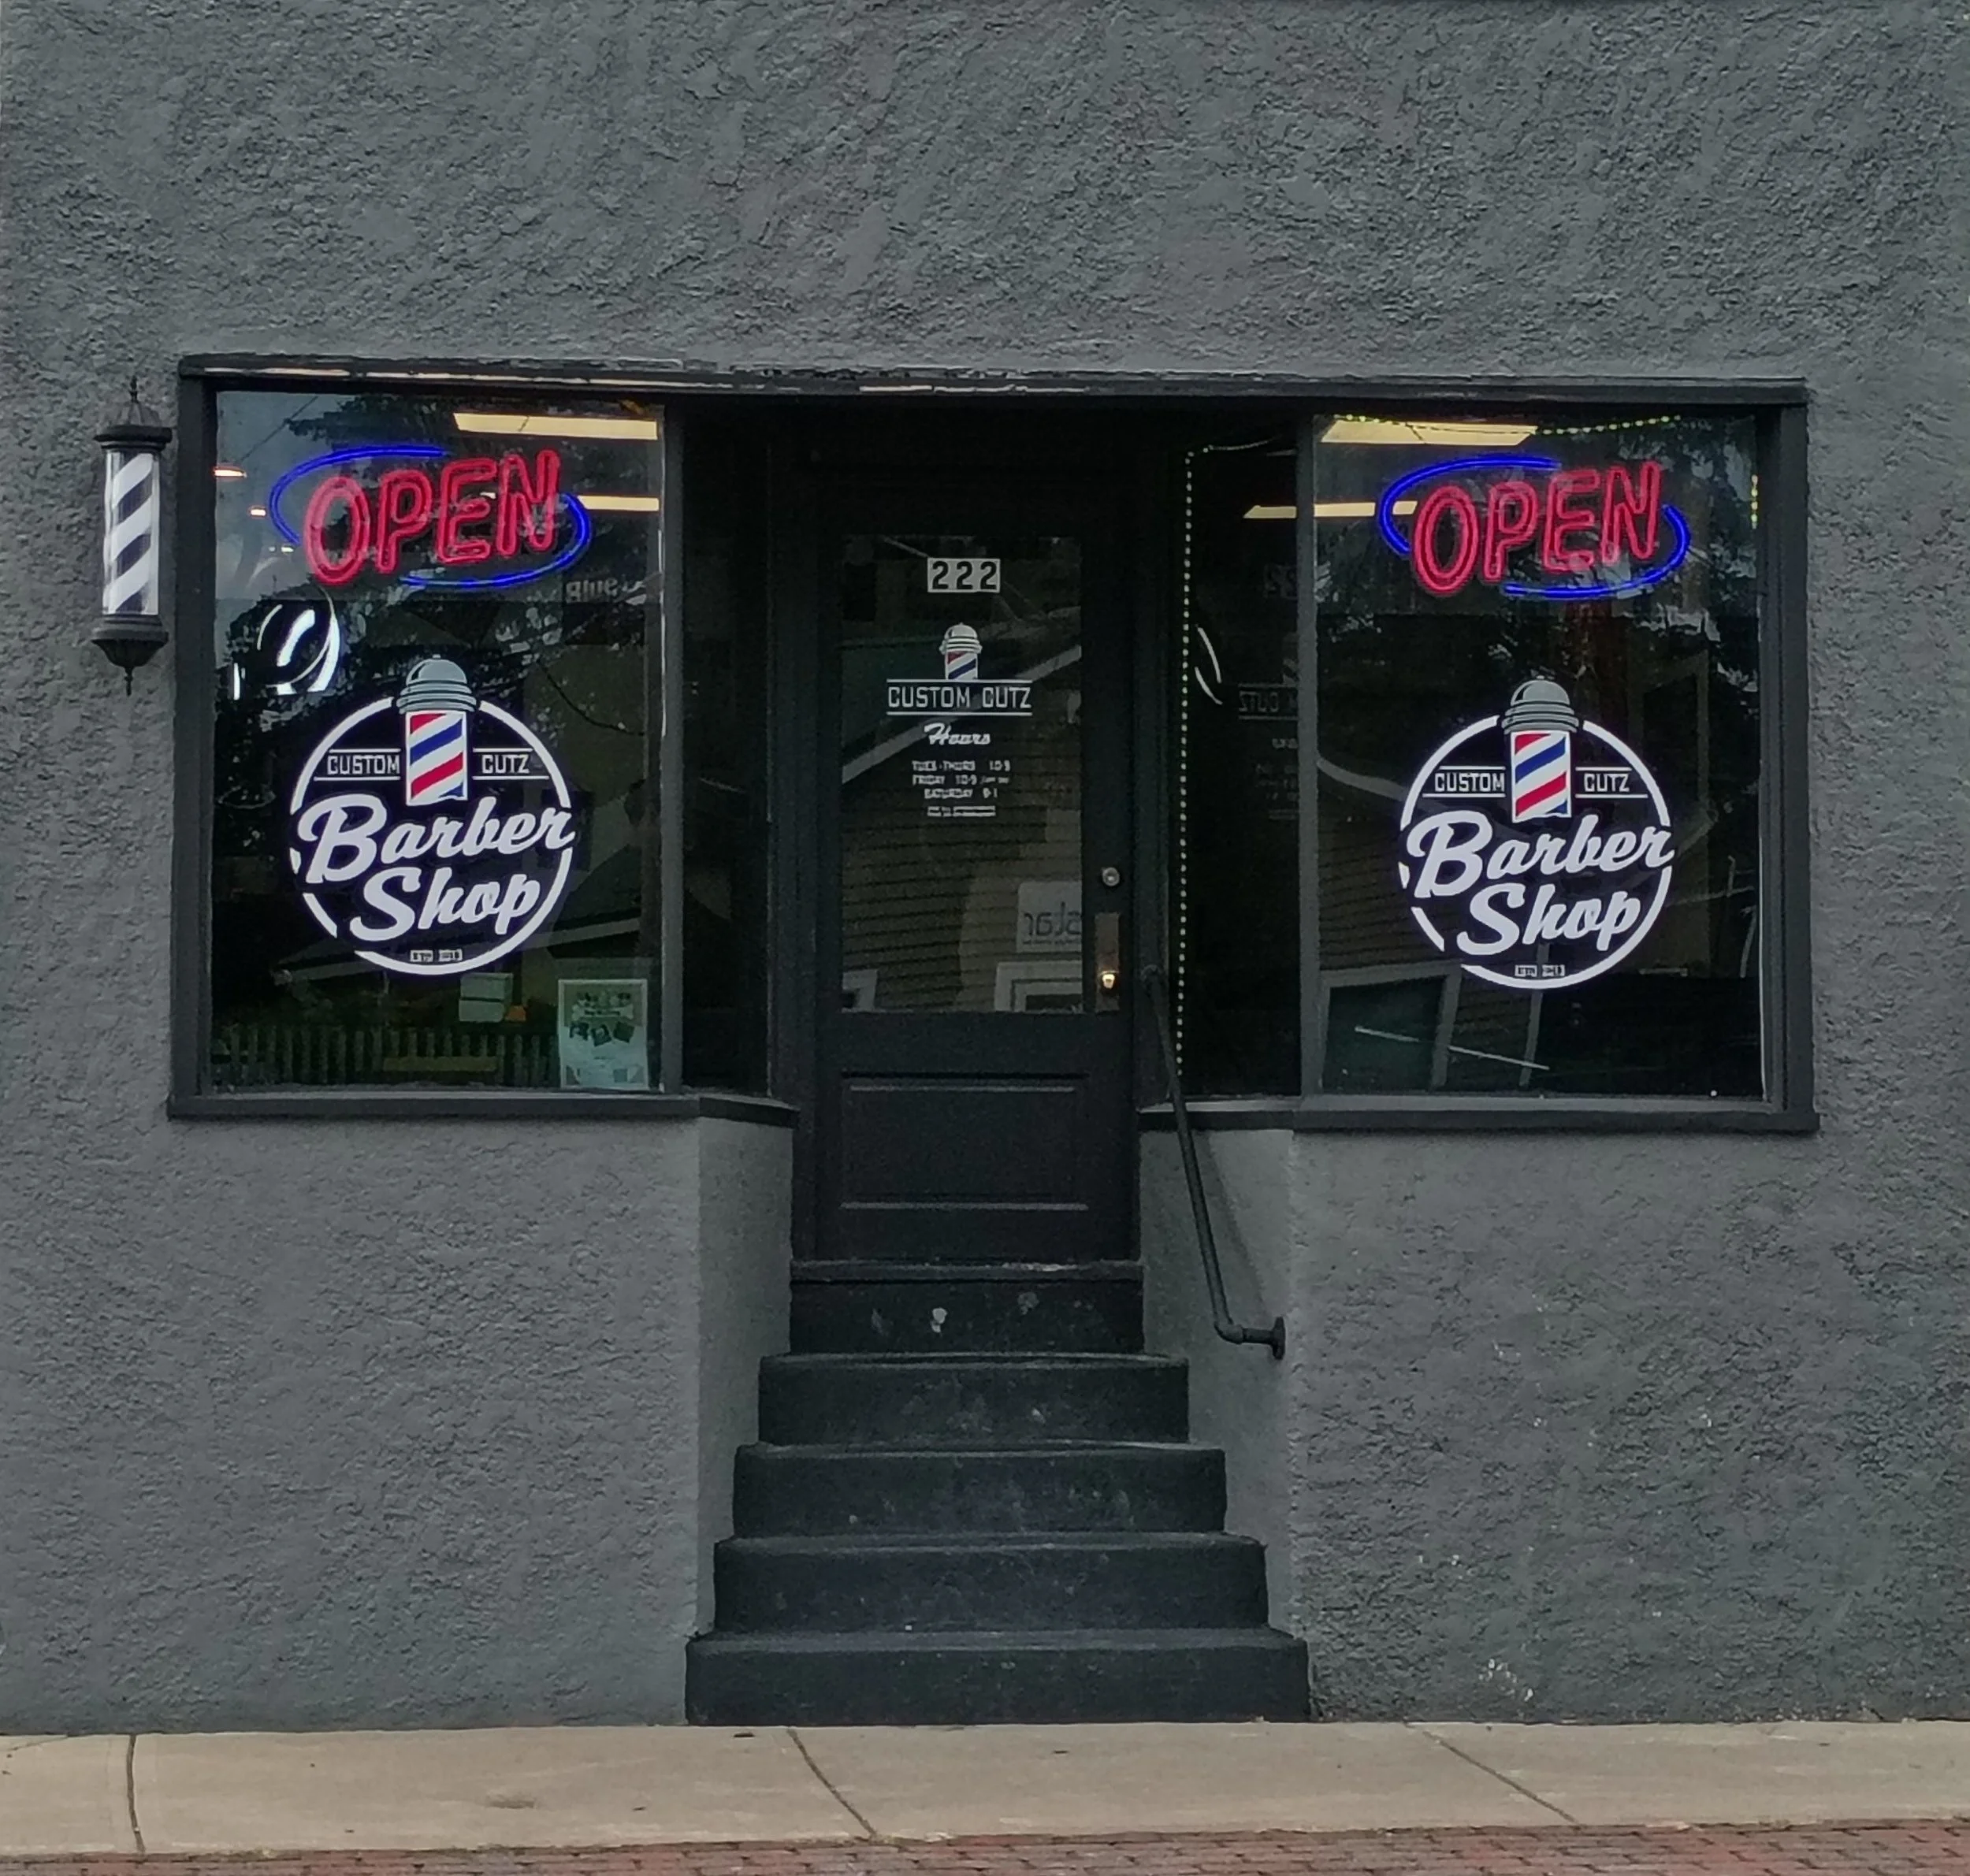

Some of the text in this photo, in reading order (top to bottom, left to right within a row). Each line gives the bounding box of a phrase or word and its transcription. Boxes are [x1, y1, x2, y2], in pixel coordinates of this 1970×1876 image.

[303, 449, 561, 586] OPEN
[1413, 459, 1663, 595] OPEN
[931, 560, 998, 590] 222
[887, 686, 1032, 709] CUSTOM CUTZ
[924, 723, 991, 745] Hours
[327, 754, 530, 775] CUSTOM CUTZ
[1434, 772, 1630, 793] CUSTOM CUTZ
[297, 793, 576, 884] Barber
[1406, 809, 1675, 899] Barber
[349, 866, 541, 942] Shop
[1456, 882, 1641, 956] Shop
